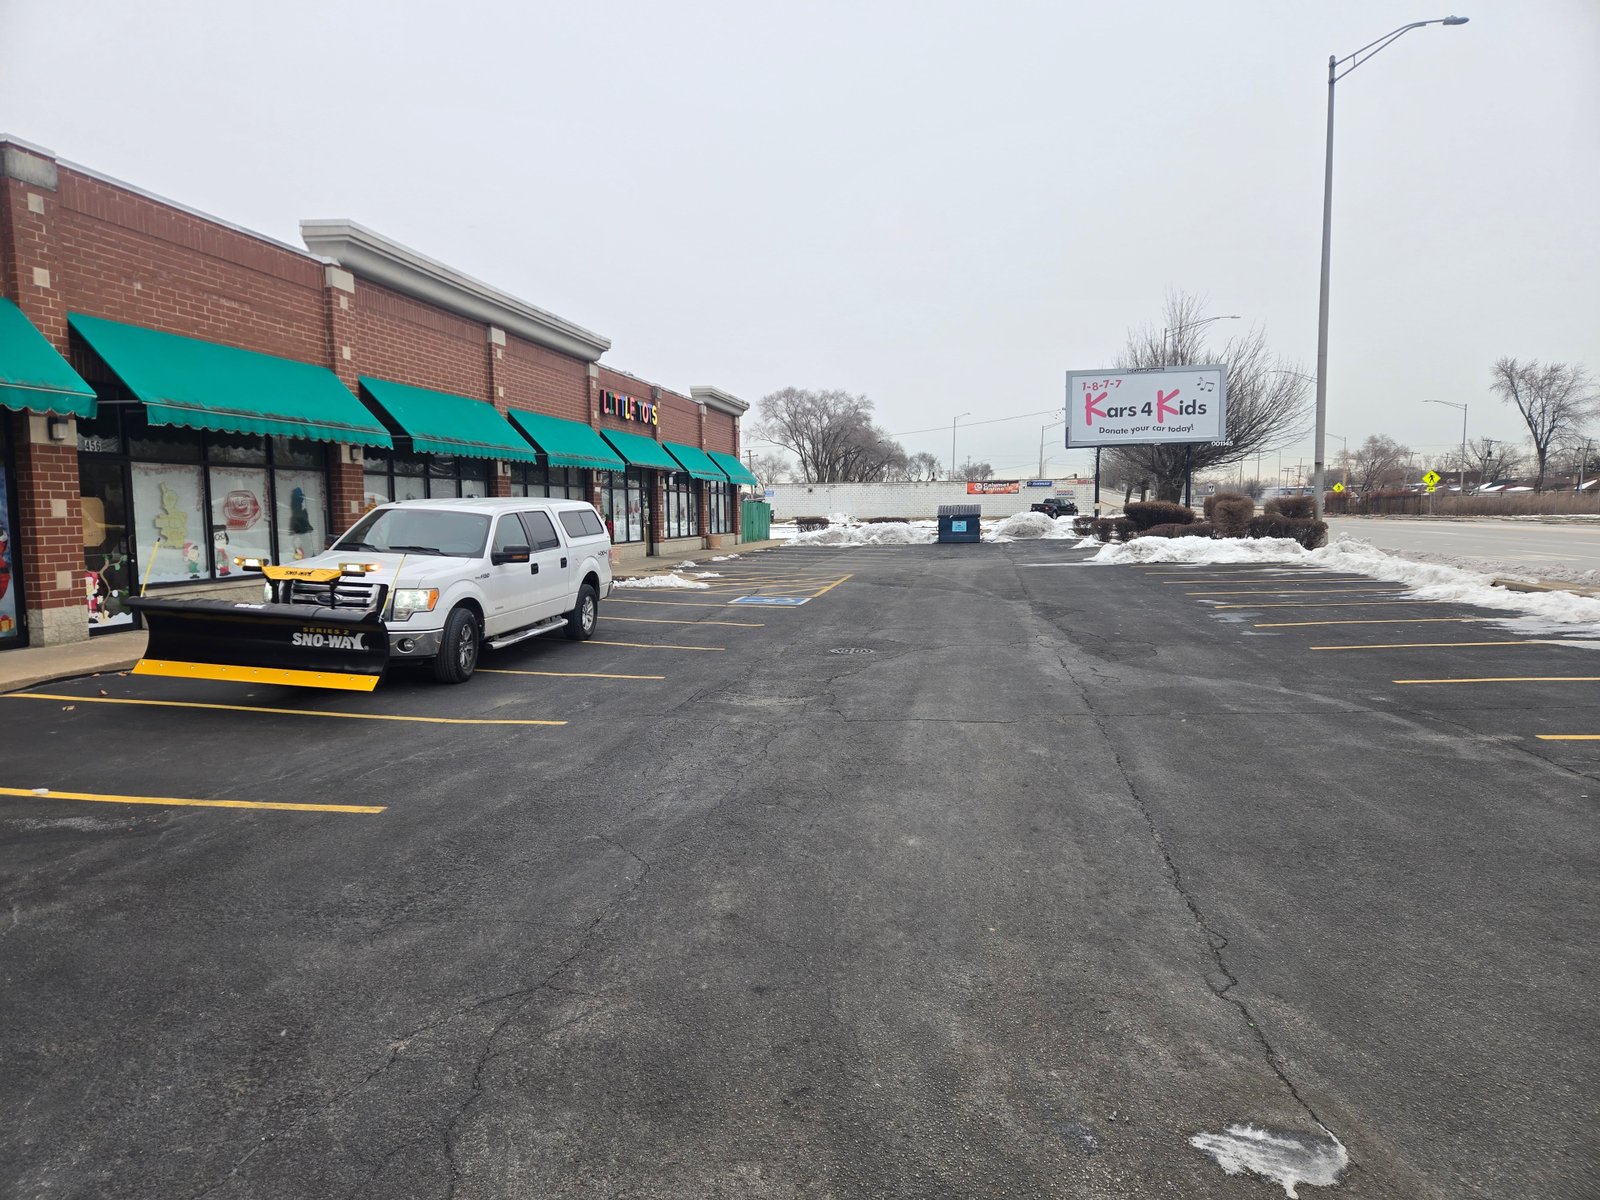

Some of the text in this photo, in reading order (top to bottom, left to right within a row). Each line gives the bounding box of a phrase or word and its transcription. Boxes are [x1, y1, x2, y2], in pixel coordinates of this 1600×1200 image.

[1082, 379, 1122, 391] 1-8-7-7
[602, 389, 658, 426] LITTLE TOTS
[1085, 388, 1207, 426] Kars 4 Kids
[1099, 426, 1129, 435] Donate
[1130, 425, 1150, 435] your
[1168, 423, 1194, 433] today!
[303, 627, 340, 635] SERIES
[292, 632, 365, 650] SNO-WAY
